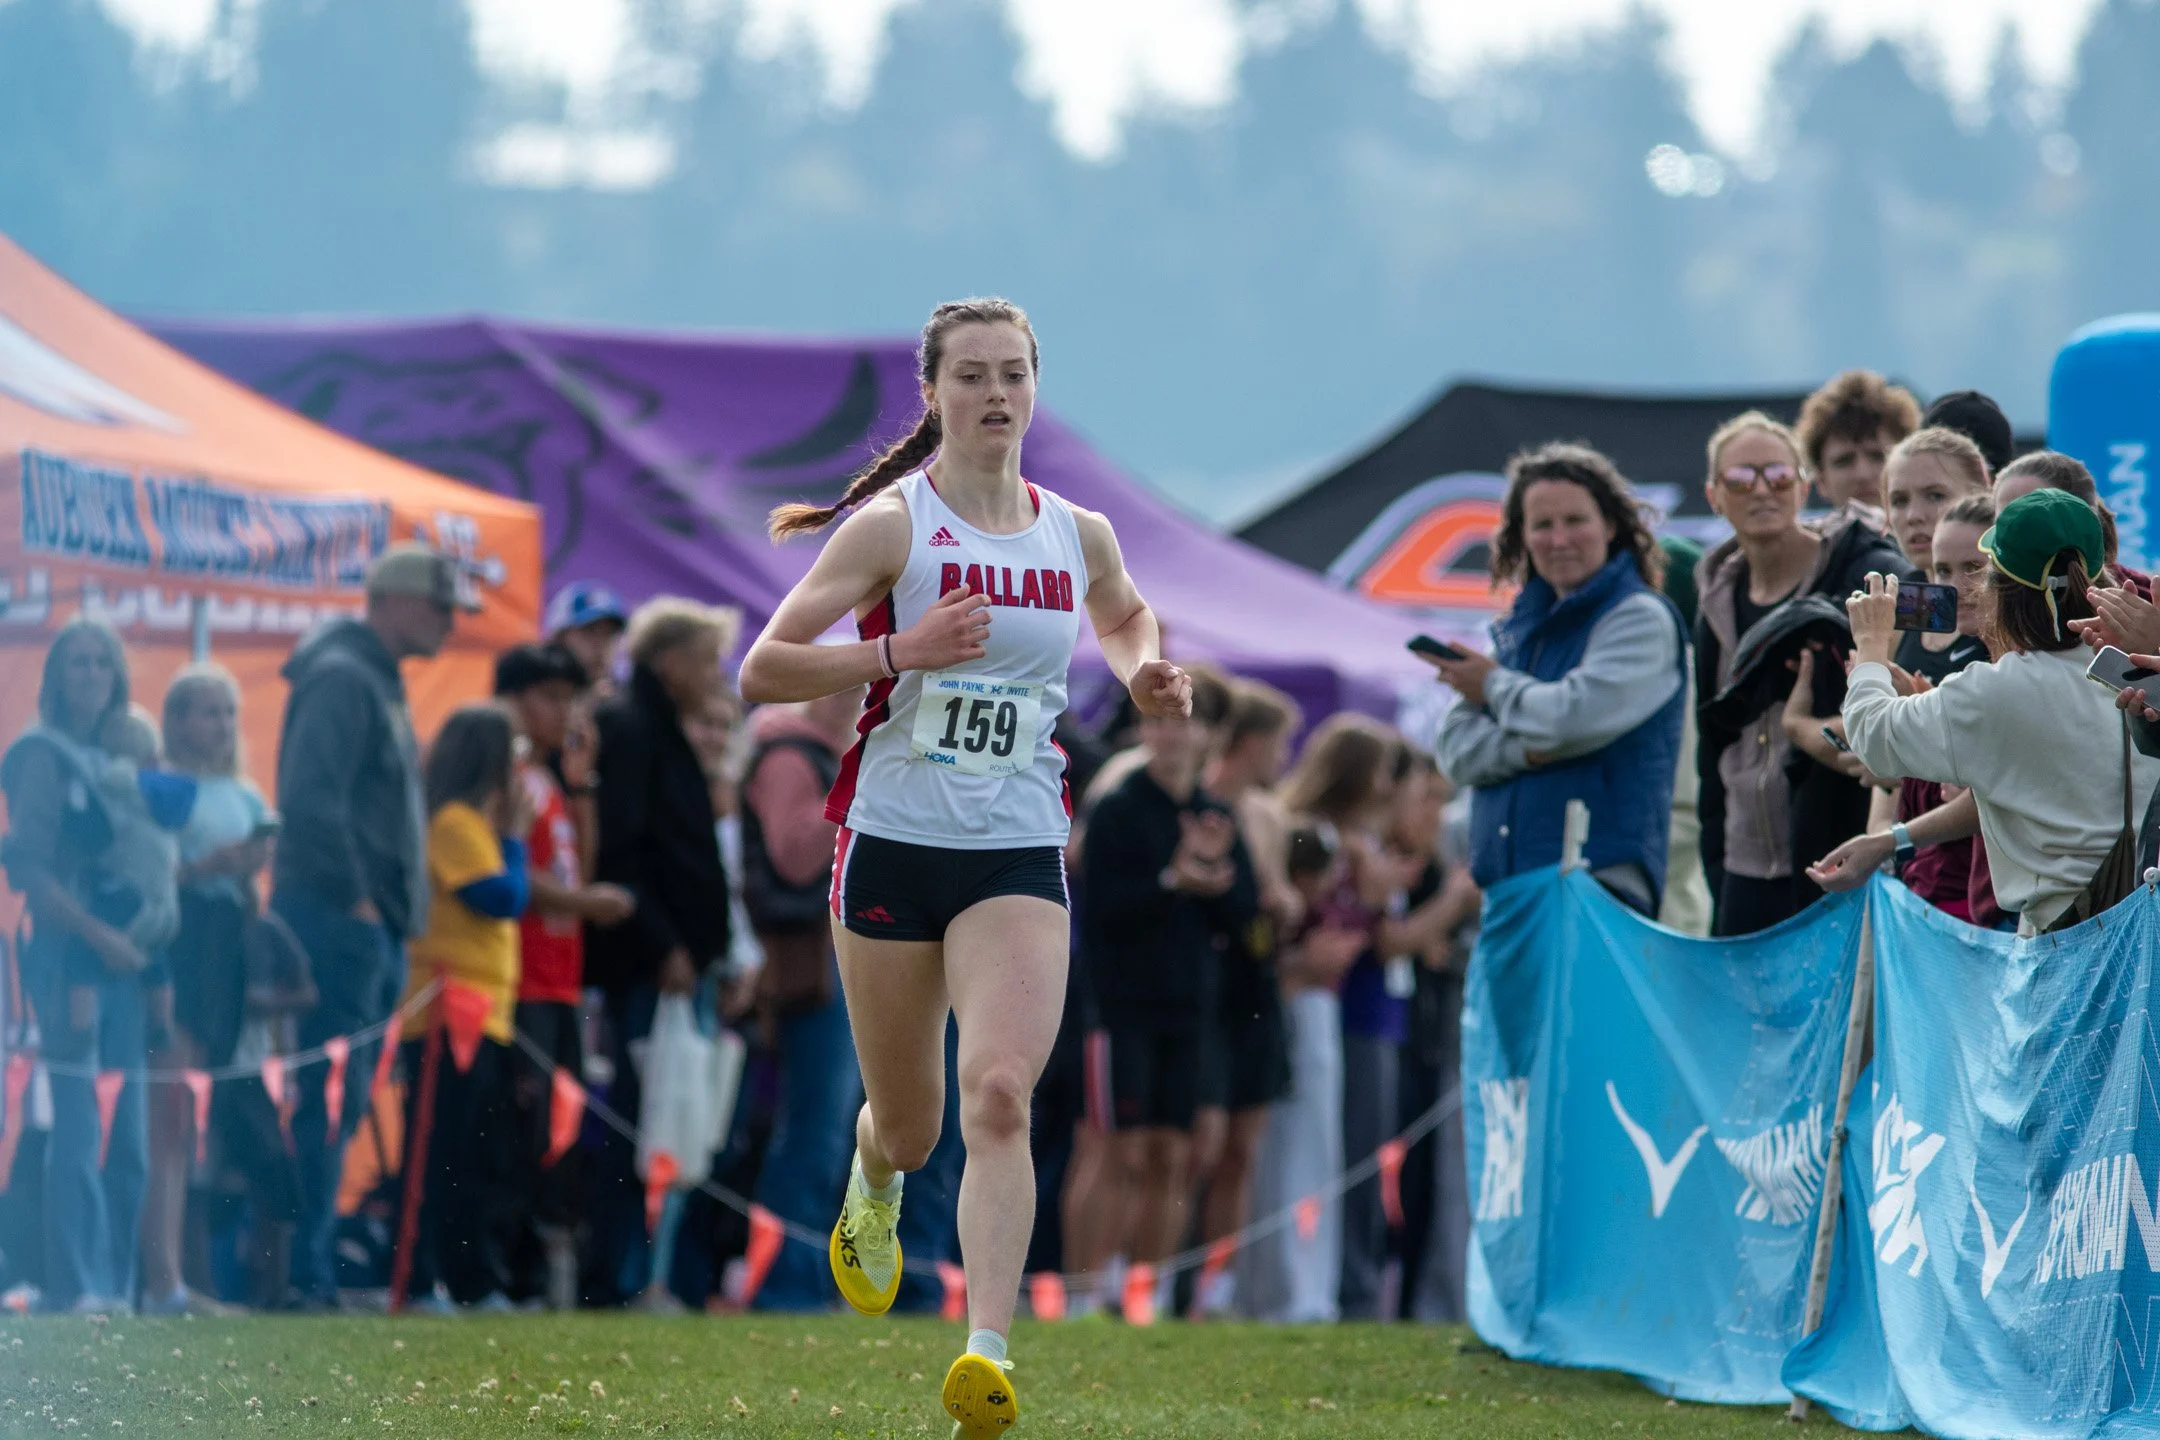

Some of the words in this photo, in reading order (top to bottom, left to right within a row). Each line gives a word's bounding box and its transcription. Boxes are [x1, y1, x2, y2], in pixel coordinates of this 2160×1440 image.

[928, 538, 960, 547] adidas
[939, 562, 1074, 612] BALLARD
[938, 680, 960, 690] JOHN
[961, 681, 985, 693] PAYNE
[1006, 686, 1030, 697] INVITE
[938, 696, 1018, 758] 159
[924, 751, 956, 765] HOKA
